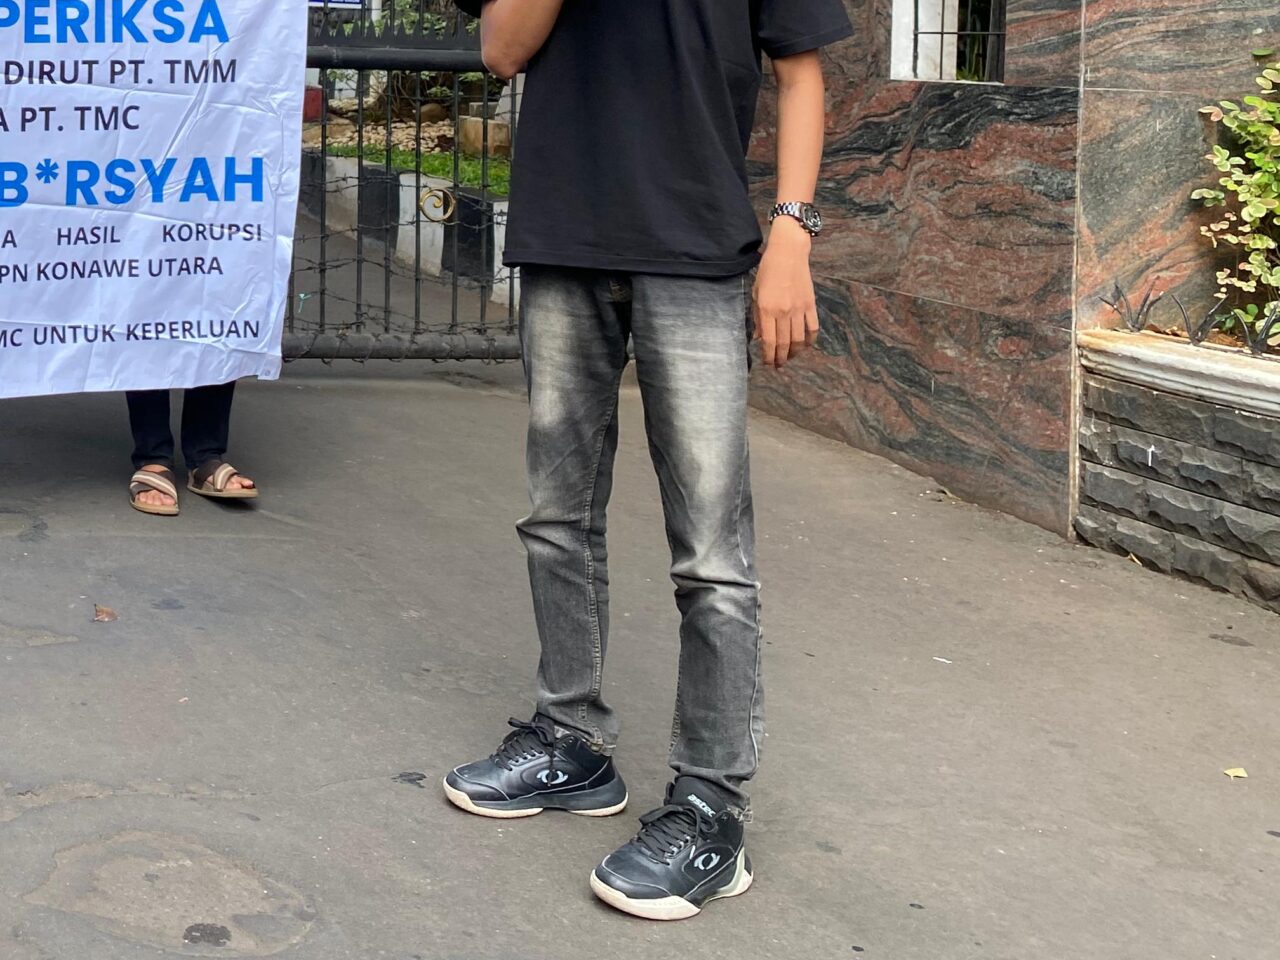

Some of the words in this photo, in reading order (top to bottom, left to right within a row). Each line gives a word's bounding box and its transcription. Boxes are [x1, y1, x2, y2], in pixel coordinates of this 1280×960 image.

[4, 60, 99, 85] DIRUT
[109, 59, 153, 84] PT.
[164, 59, 237, 84] TMM
[20, 106, 64, 132] PT.
[74, 105, 140, 131] TMC
[57, 225, 121, 246] HASIL
[163, 223, 262, 243] KORUPSI
[37, 259, 140, 281] KONAWE
[148, 256, 223, 277] UTARA
[33, 324, 116, 346] UNTUK
[126, 320, 260, 341] KEPERLUAN
